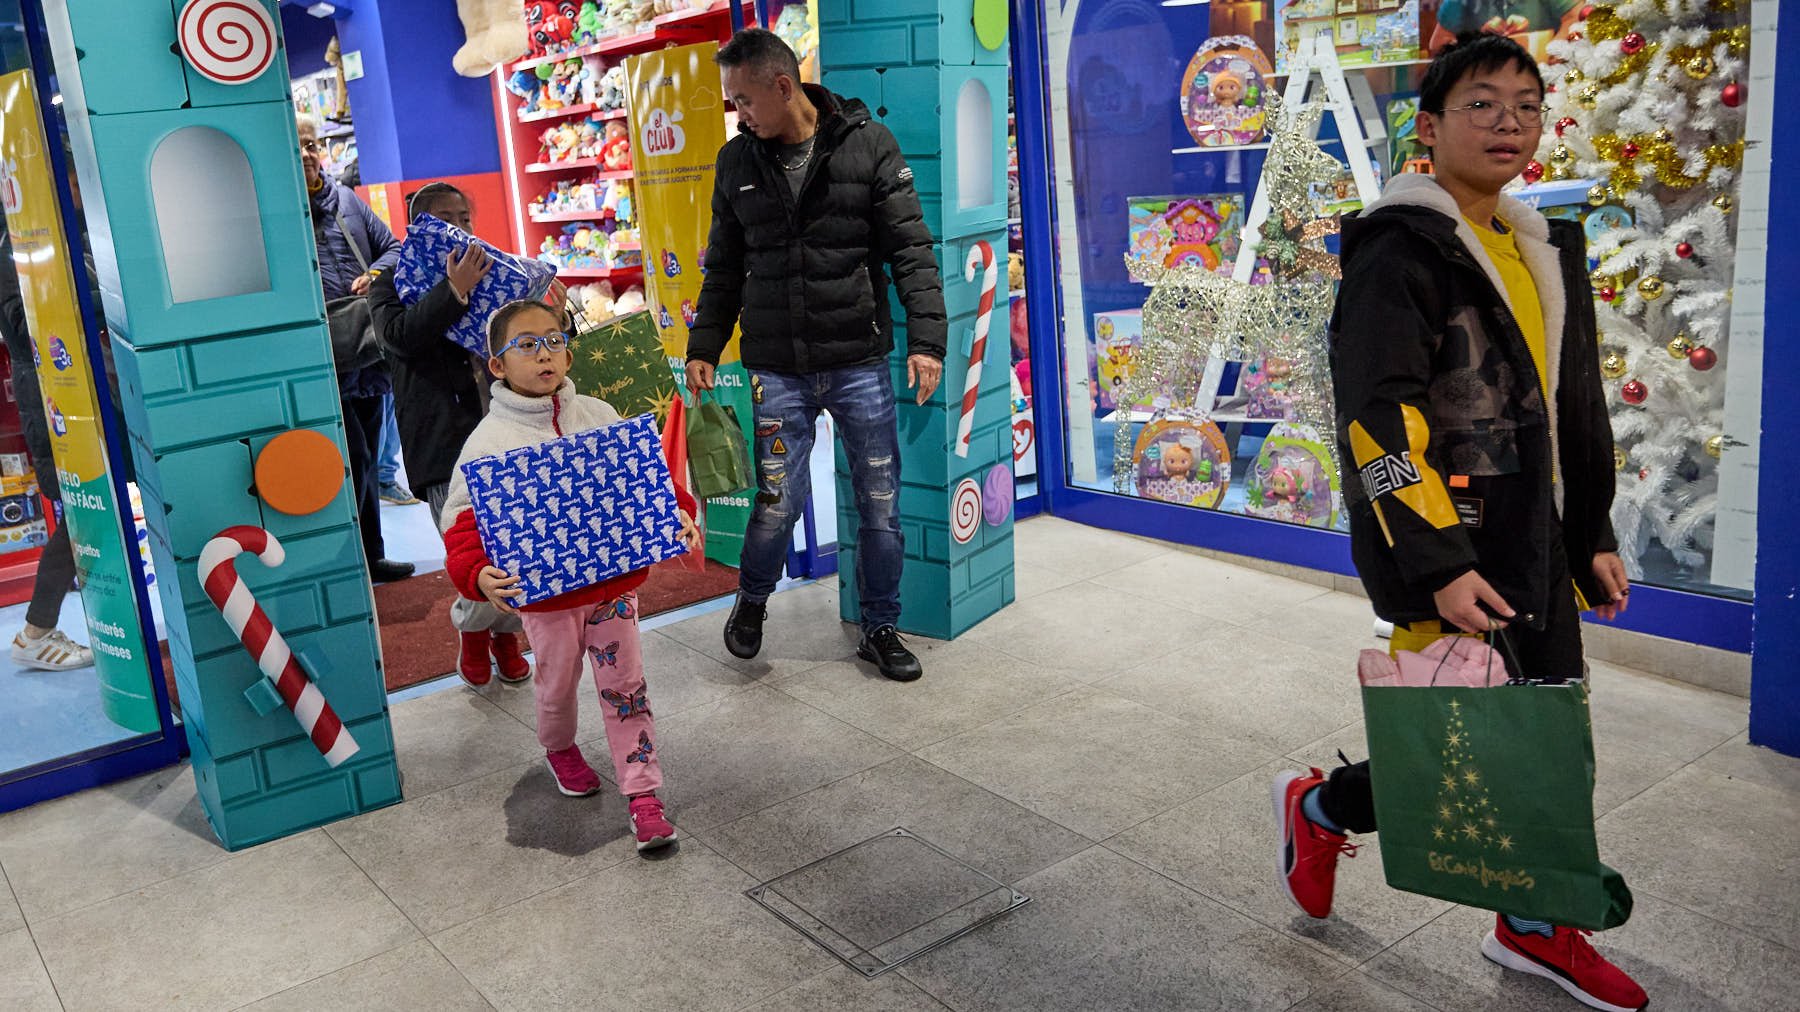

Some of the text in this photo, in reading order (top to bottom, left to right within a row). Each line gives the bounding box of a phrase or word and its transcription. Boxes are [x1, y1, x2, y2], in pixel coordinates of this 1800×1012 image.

[654, 112, 663, 128] el
[647, 126, 676, 153] CLUB
[667, 356, 686, 370] ORA
[714, 371, 743, 387] ÁCIL
[76, 489, 106, 511] FÁCIL
[101, 641, 132, 660] meses
